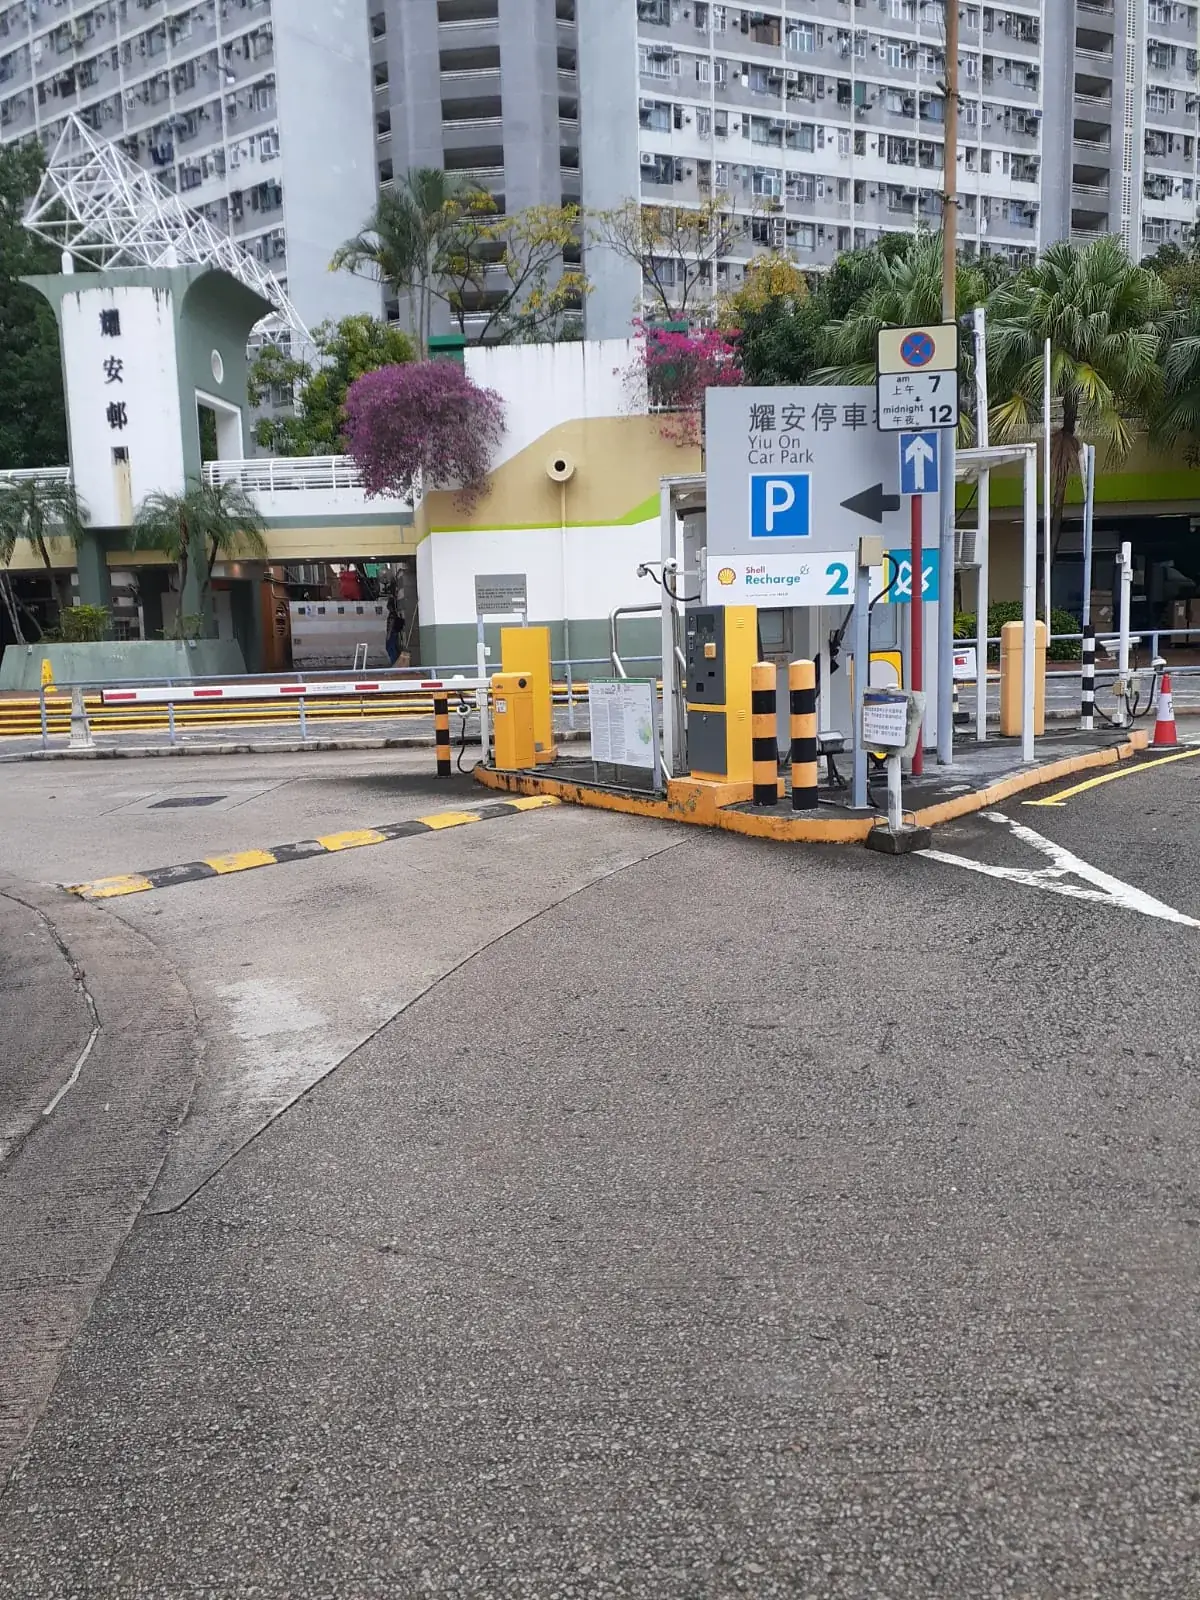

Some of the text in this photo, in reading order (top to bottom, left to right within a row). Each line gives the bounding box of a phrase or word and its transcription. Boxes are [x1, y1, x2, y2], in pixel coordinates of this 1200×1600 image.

[891, 385, 915, 396] 上午
[928, 375, 941, 393] 7
[883, 404, 924, 414] midnight
[929, 404, 953, 423] 12
[748, 402, 878, 433] 耀安停車
[748, 434, 800, 449] Yiu On
[748, 448, 815, 465] Car Park
[765, 480, 795, 531] P
[745, 565, 766, 574] Shell
[745, 574, 801, 586] Recharge
